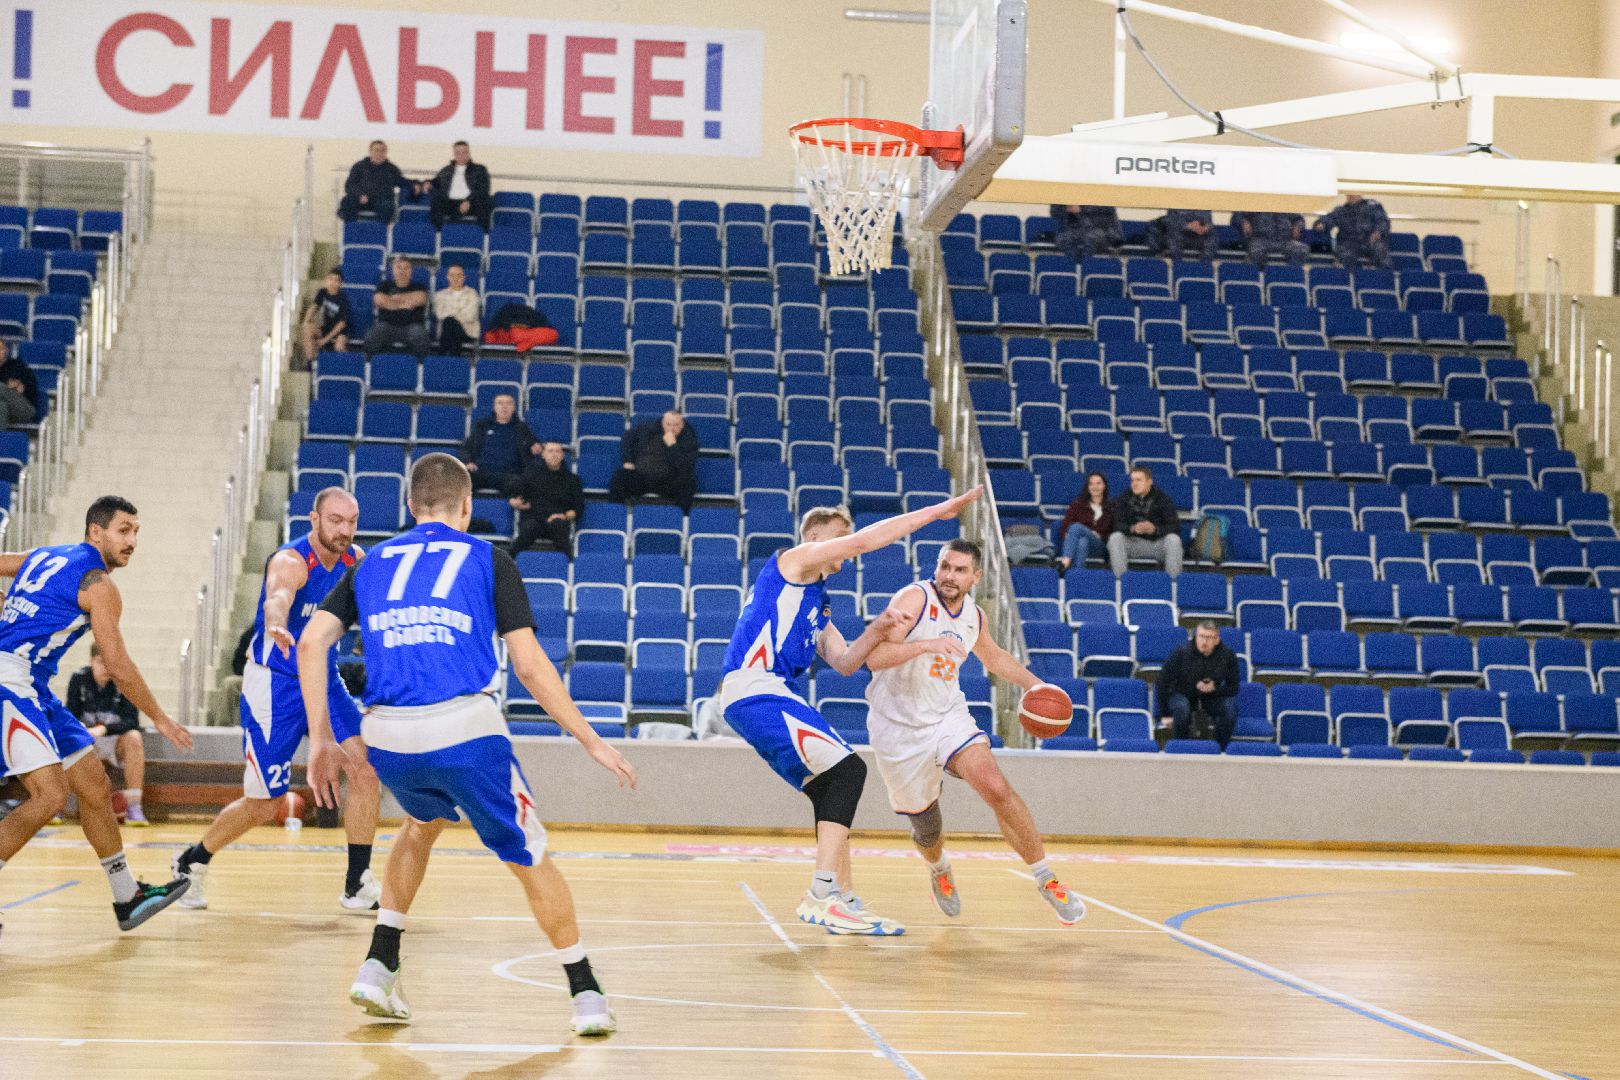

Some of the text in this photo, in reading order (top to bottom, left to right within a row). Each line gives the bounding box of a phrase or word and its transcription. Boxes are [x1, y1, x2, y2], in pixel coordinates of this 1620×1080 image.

[95, 11, 725, 139] СИЛЬНЕЕ!
[1115, 156, 1216, 175] porter
[380, 541, 472, 601] 77
[267, 760, 292, 789] 23
